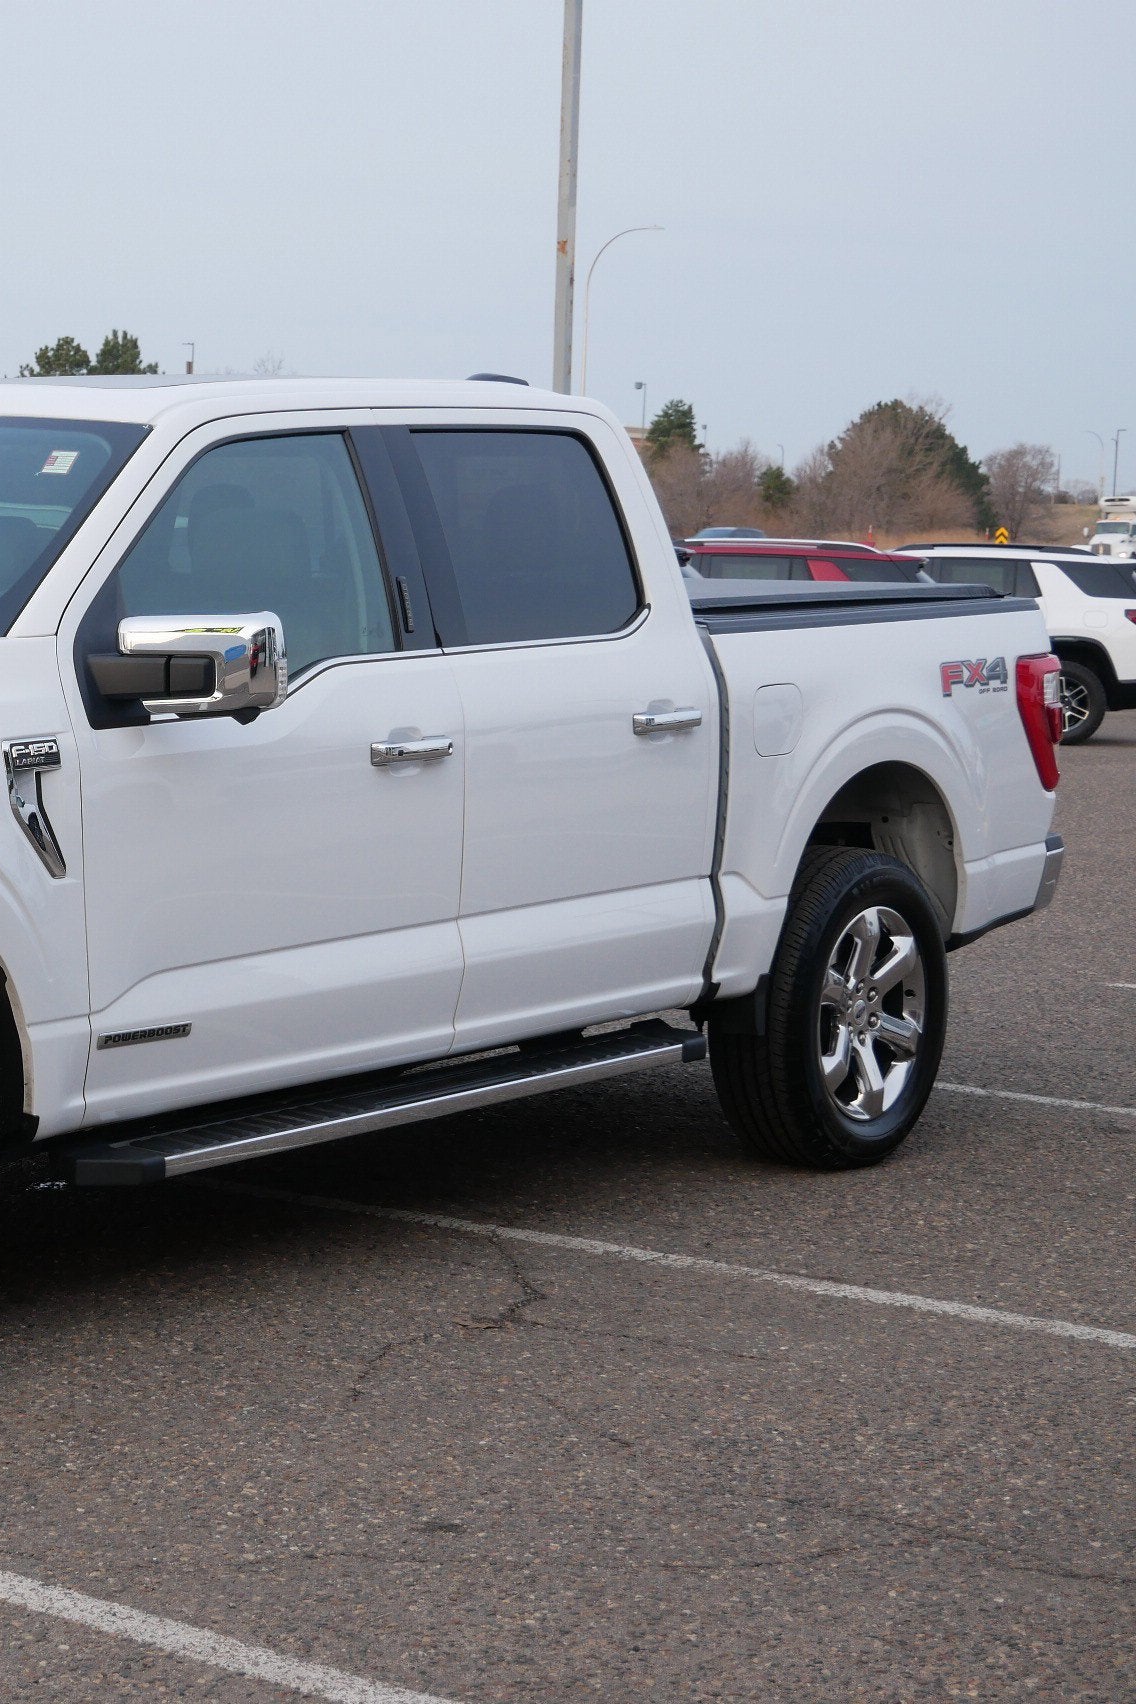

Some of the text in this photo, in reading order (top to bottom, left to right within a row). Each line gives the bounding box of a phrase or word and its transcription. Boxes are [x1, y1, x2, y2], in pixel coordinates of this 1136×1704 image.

[940, 657, 1008, 698] FX4
[978, 687, 991, 695] OFF
[11, 741, 59, 758] F-150
[15, 756, 46, 766] LARIAT
[103, 1023, 189, 1044] POWERBOOST
